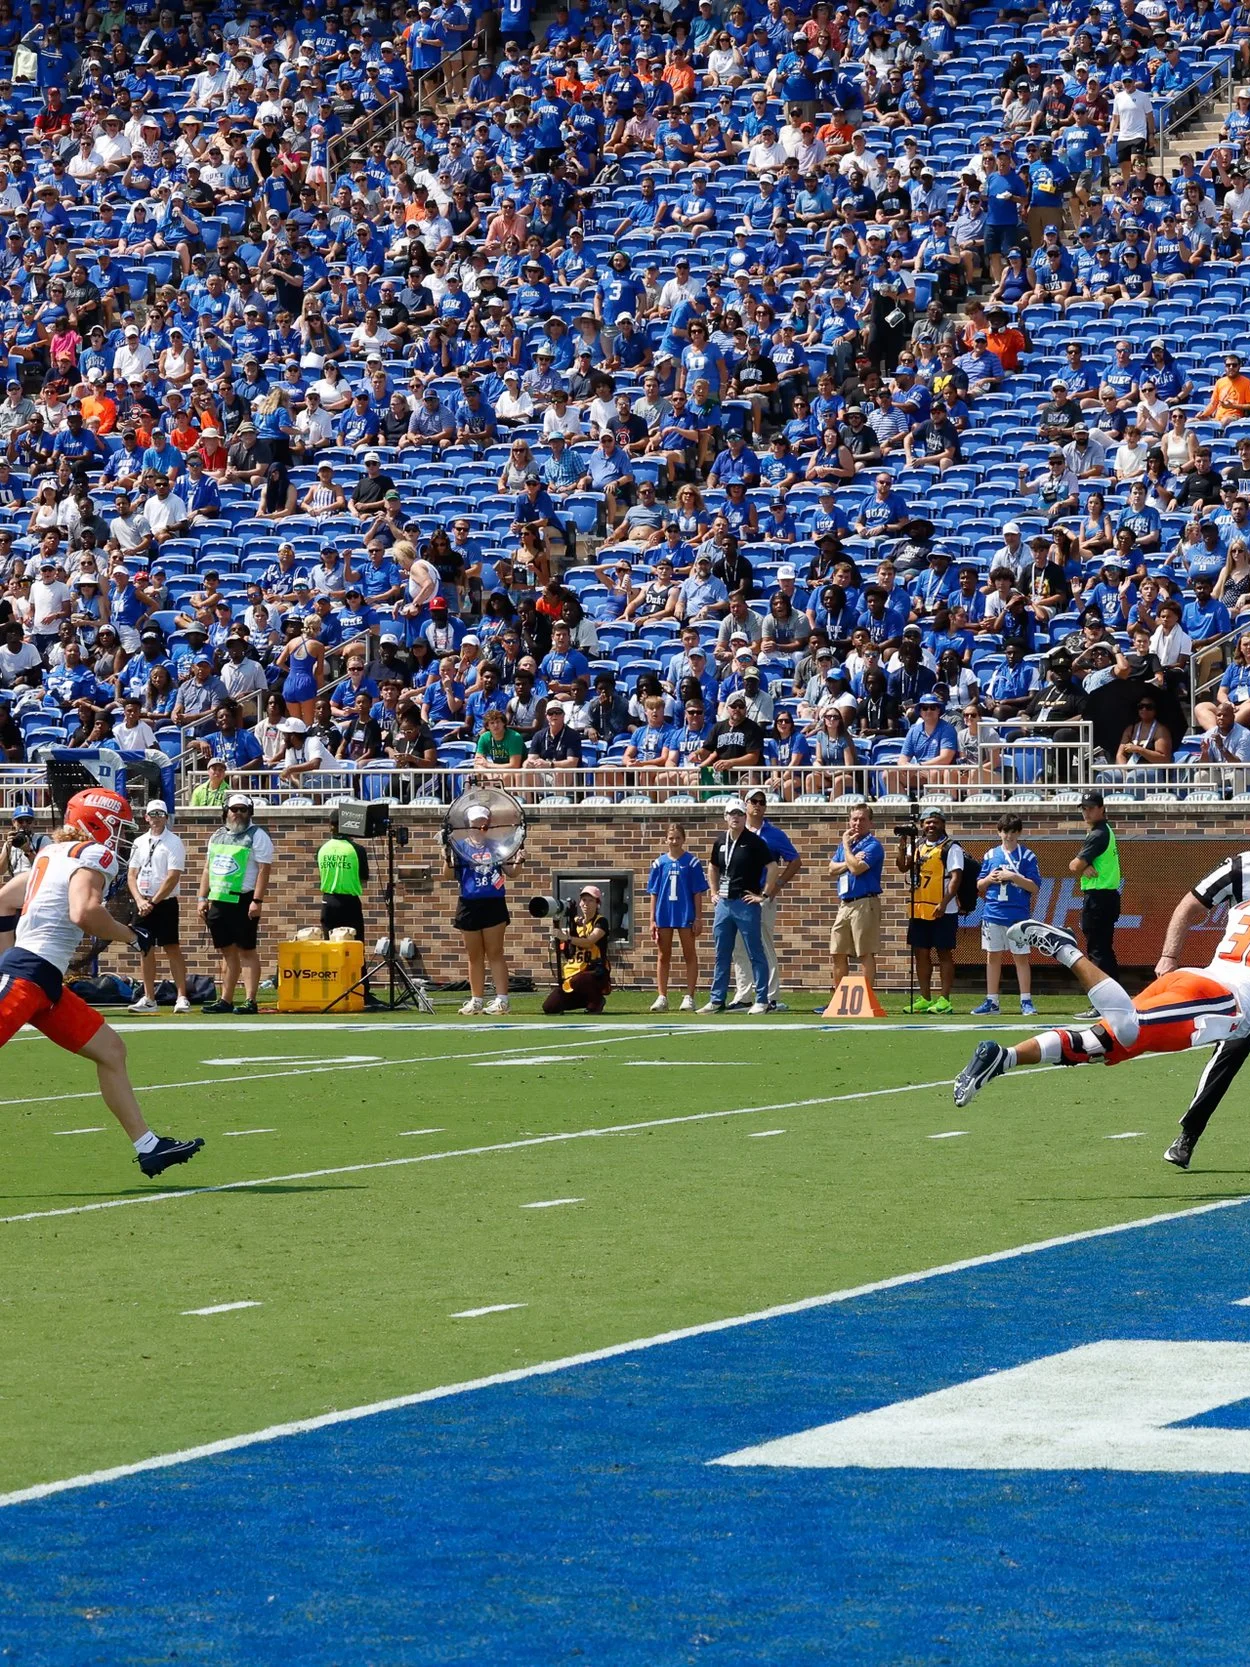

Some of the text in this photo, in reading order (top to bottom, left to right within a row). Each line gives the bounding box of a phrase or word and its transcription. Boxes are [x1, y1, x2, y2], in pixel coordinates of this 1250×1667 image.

[316, 38, 335, 47] DUKE
[610, 283, 623, 300] 3
[773, 353, 795, 363] DUKE
[1108, 374, 1131, 385] DUKE
[866, 509, 891, 518] DUKE
[646, 594, 666, 605] Duke
[680, 741, 704, 752] DUK
[83, 794, 122, 813] ILLINOIS
[323, 854, 347, 862] EVENT
[320, 861, 351, 870] SERVICES
[668, 875, 679, 901] 1
[837, 985, 864, 1015] 10
